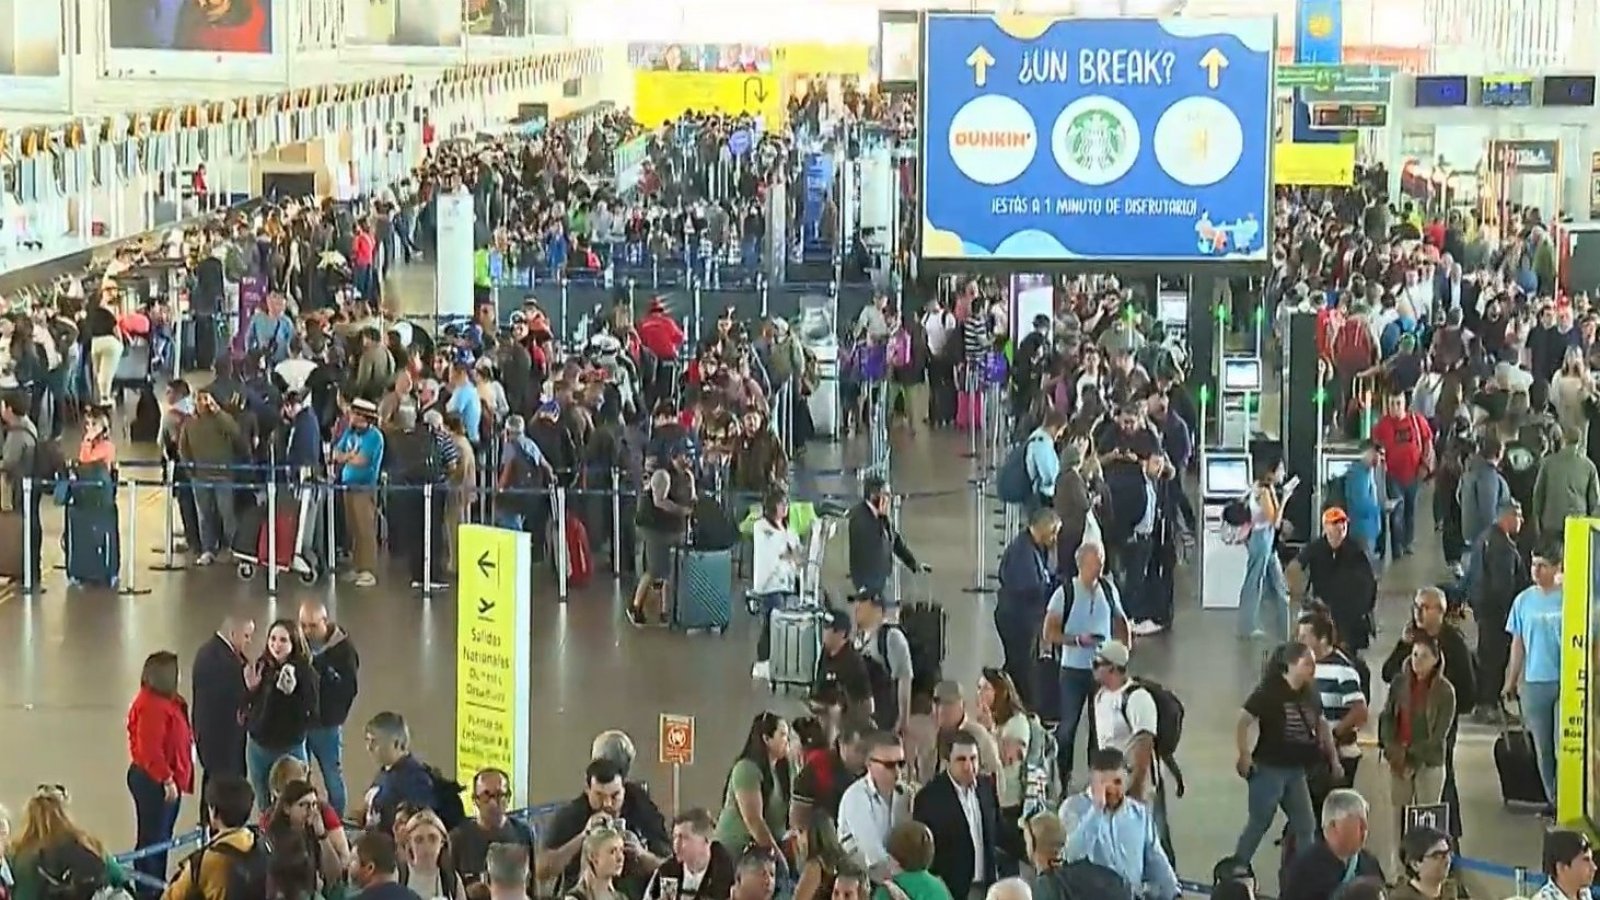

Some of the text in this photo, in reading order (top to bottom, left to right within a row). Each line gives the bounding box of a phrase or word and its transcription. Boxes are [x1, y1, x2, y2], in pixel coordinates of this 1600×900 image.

[1018, 48, 1175, 86] ¿UN BREAK?
[955, 131, 1031, 148] DUNKIN'
[1031, 198, 1041, 214] A
[1043, 198, 1051, 214] 1
[1056, 199, 1101, 216] MINUTO
[1106, 200, 1121, 216] DE
[1125, 197, 1197, 217] DISFRUTARLO!
[471, 627, 501, 647] Salidas
